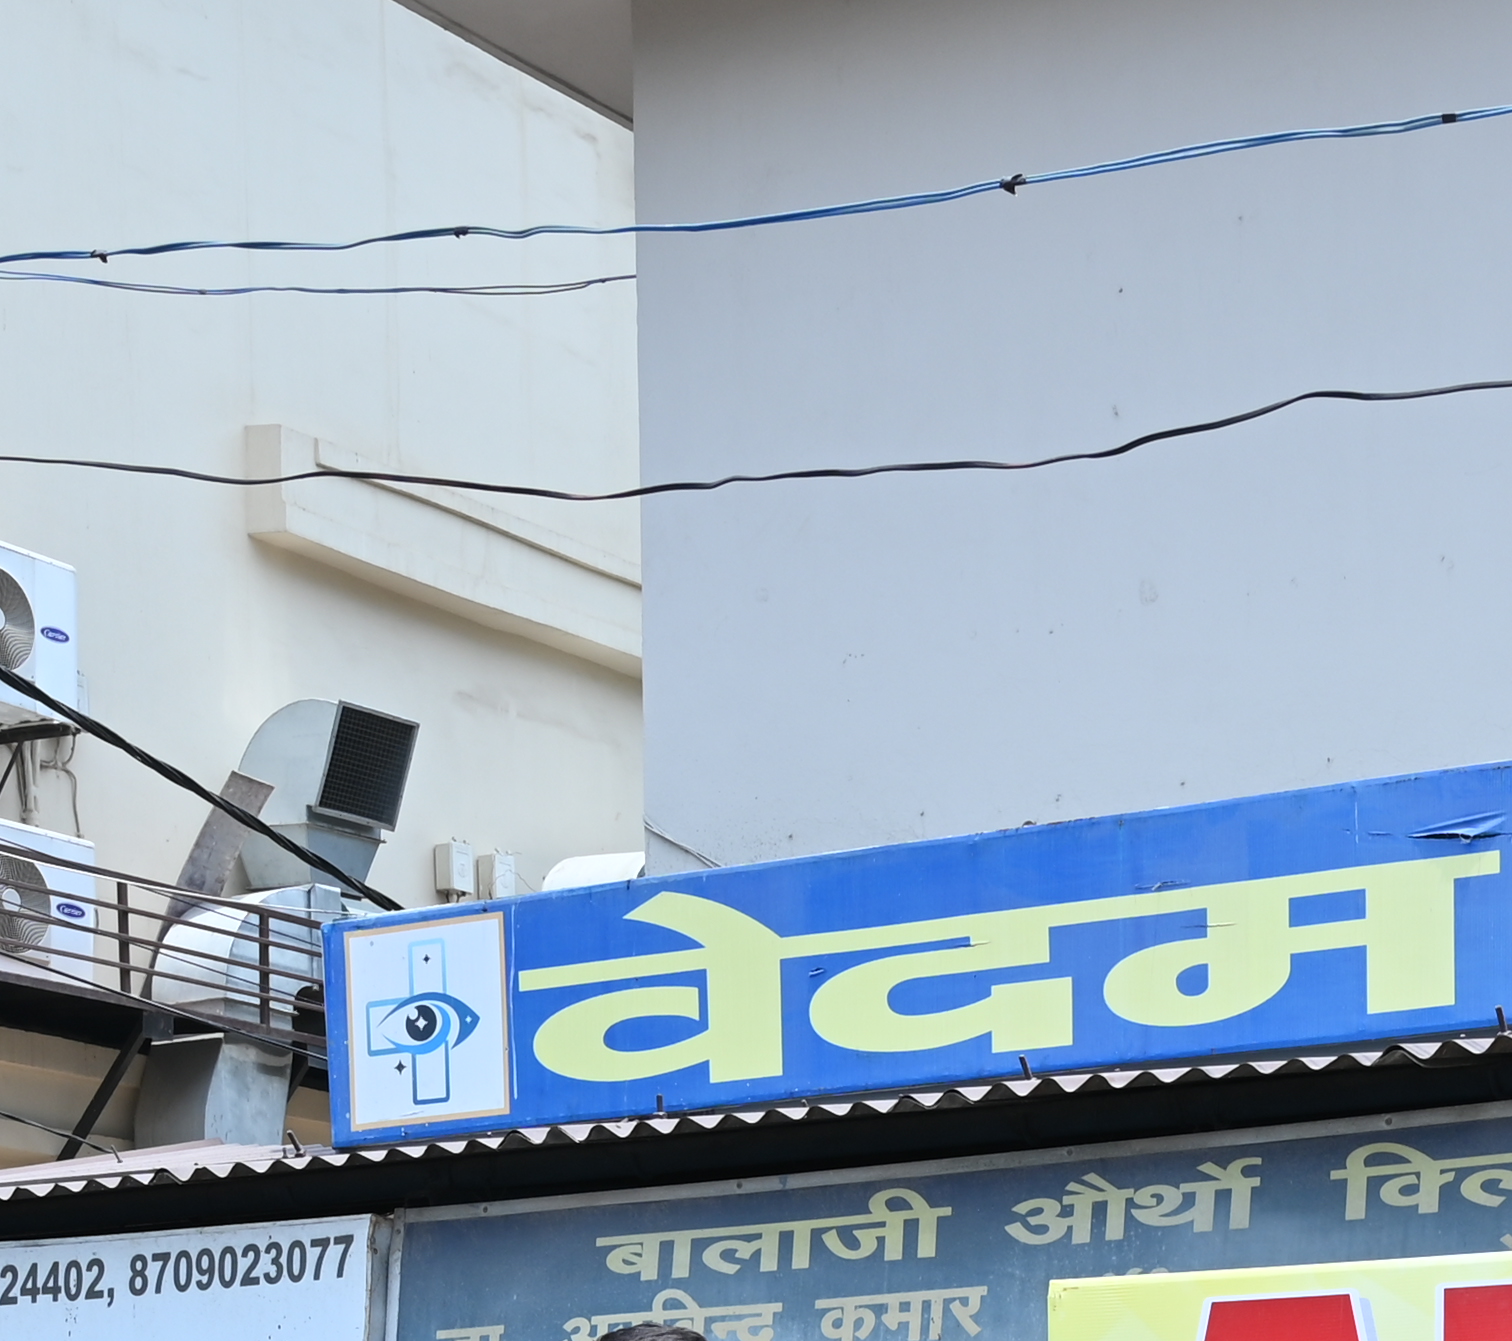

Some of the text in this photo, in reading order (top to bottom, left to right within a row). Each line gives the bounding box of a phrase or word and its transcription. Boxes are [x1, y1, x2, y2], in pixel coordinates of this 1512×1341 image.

[519, 850, 1501, 1084] वेदम
[128, 1234, 355, 1298] 8709023077
[596, 1188, 952, 1281] बालाजी
